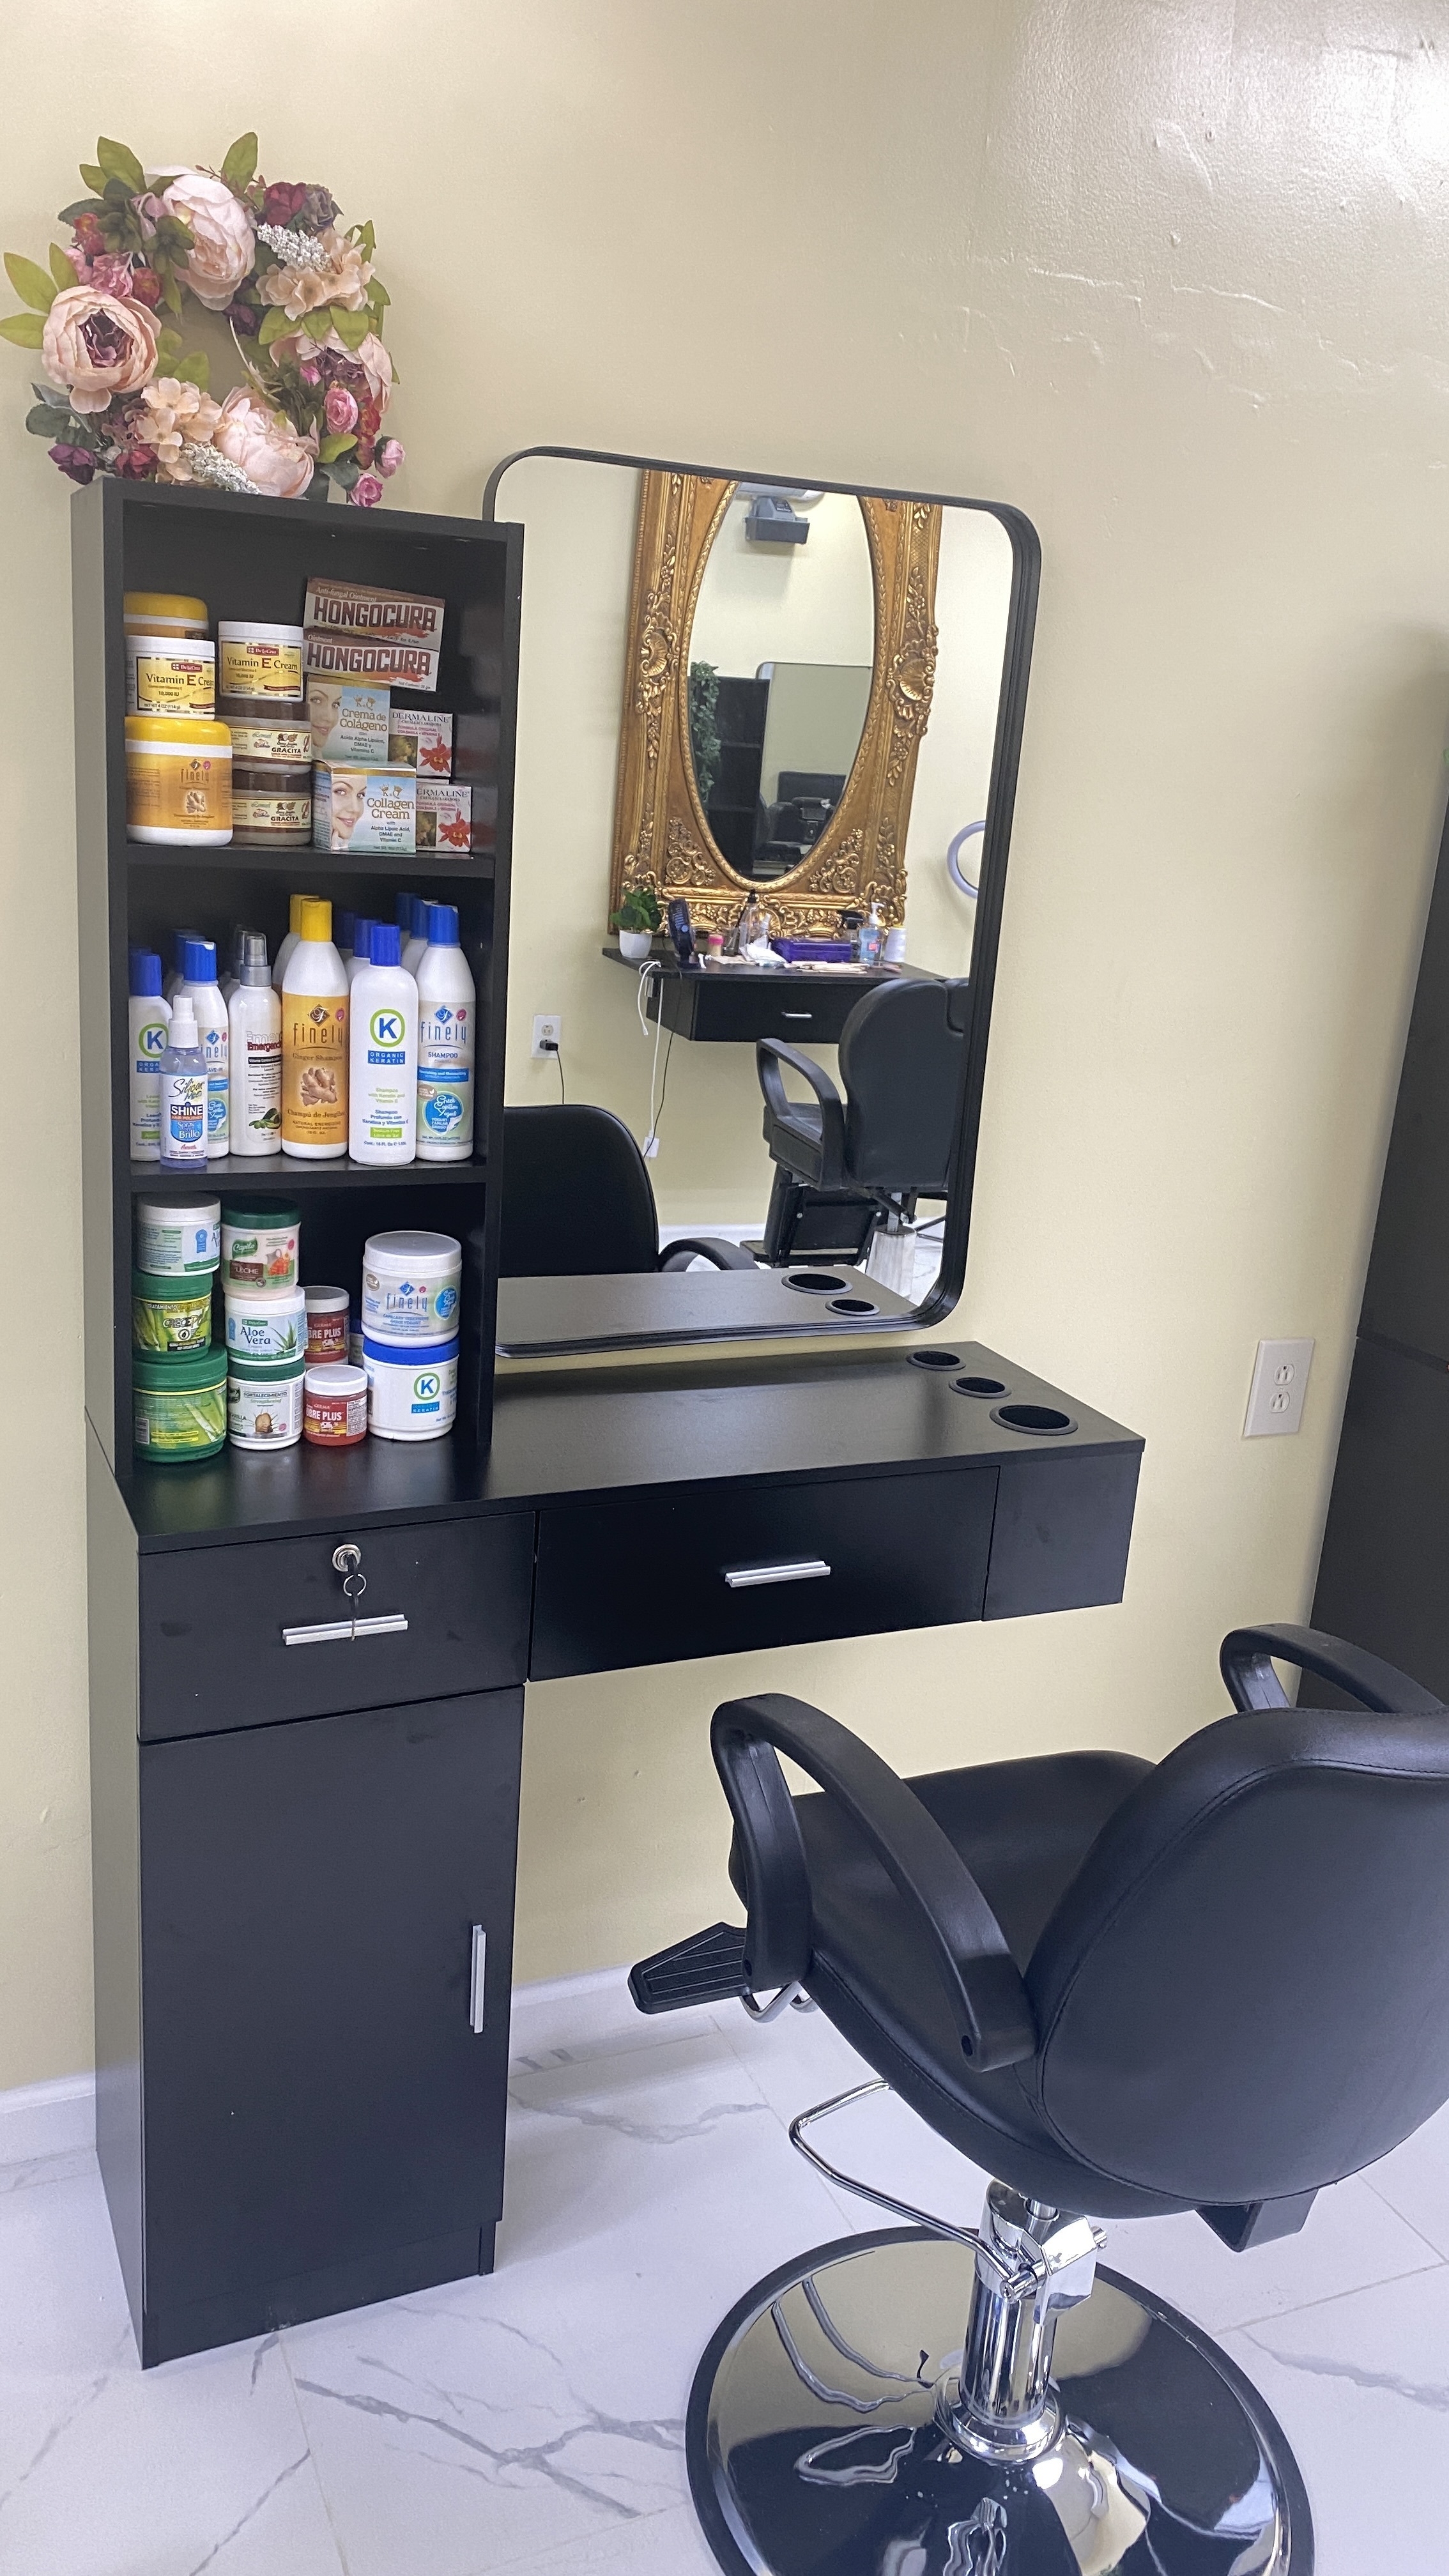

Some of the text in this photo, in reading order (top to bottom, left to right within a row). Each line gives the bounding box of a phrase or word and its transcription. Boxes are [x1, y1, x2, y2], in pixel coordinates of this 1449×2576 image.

[314, 596, 436, 632] HONGOCURA
[227, 657, 298, 670] Vitamin E Cream
[307, 642, 431, 676] HONGOCURA
[146, 673, 185, 684] Vitamin
[187, 674, 197, 686] E
[342, 709, 375, 720] Crema
[392, 712, 449, 723] DERMALINE
[340, 718, 387, 732] Colágeno
[180, 769, 210, 784] finely
[416, 789, 468, 798] ERMALINE
[367, 798, 415, 811] Collagen
[371, 808, 410, 820] Cream
[293, 1022, 342, 1046] finely
[379, 1018, 397, 1039] K
[420, 1021, 466, 1045] finely
[147, 1030, 164, 1050] K
[199, 1044, 227, 1059] inely
[171, 1105, 203, 1116] SHINE
[179, 1130, 200, 1138] Brillo
[233, 1242, 255, 1254] Capilo
[235, 1266, 259, 1275] LECHE
[387, 1293, 427, 1312] finely
[240, 1326, 265, 1337] Aloe
[307, 1328, 341, 1339] BRE PLUS
[245, 1335, 271, 1345] Vera
[420, 1378, 434, 1395] K
[322, 1411, 342, 1422] PLUS
